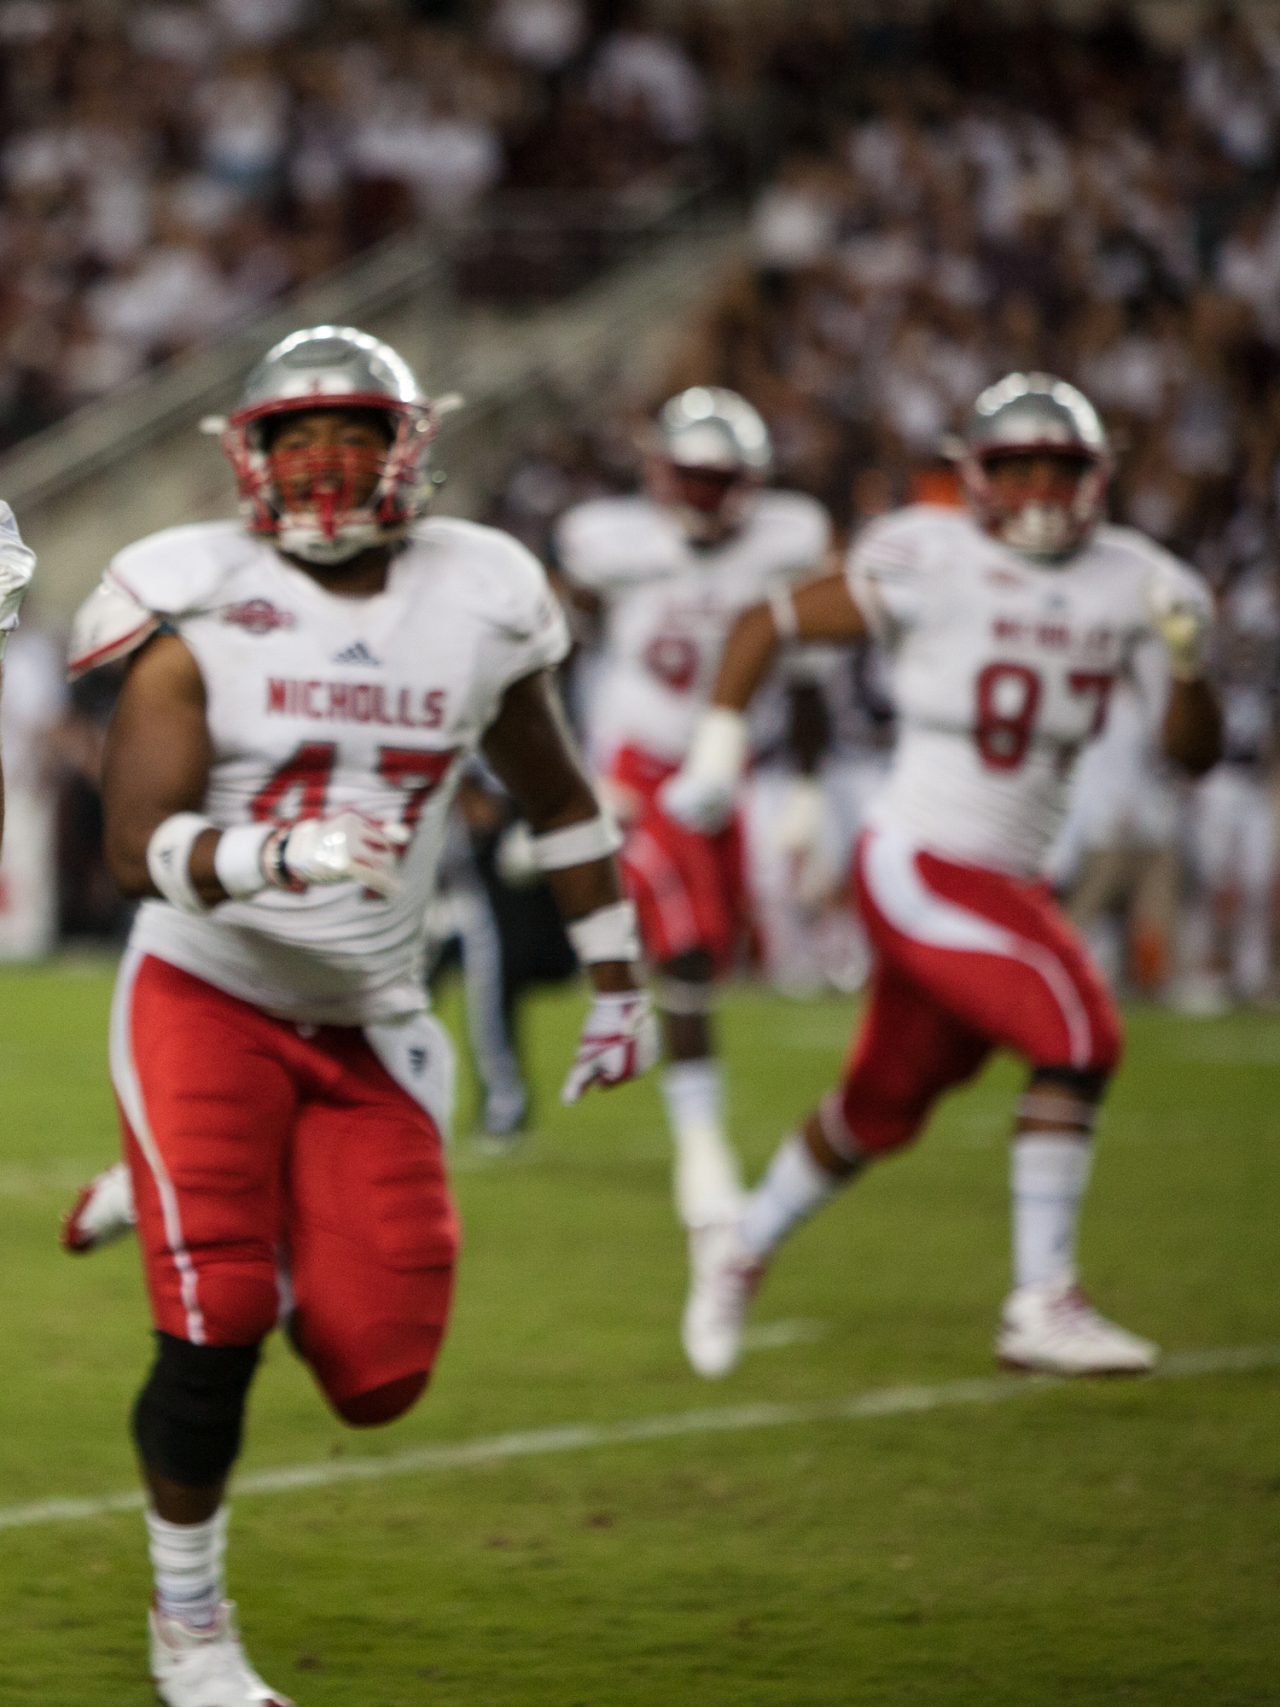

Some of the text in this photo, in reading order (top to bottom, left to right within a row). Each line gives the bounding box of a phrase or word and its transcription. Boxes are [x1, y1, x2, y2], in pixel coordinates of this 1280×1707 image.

[266, 676, 448, 731] NICHOLLS
[976, 662, 1119, 774] 87
[249, 739, 462, 900] 47
